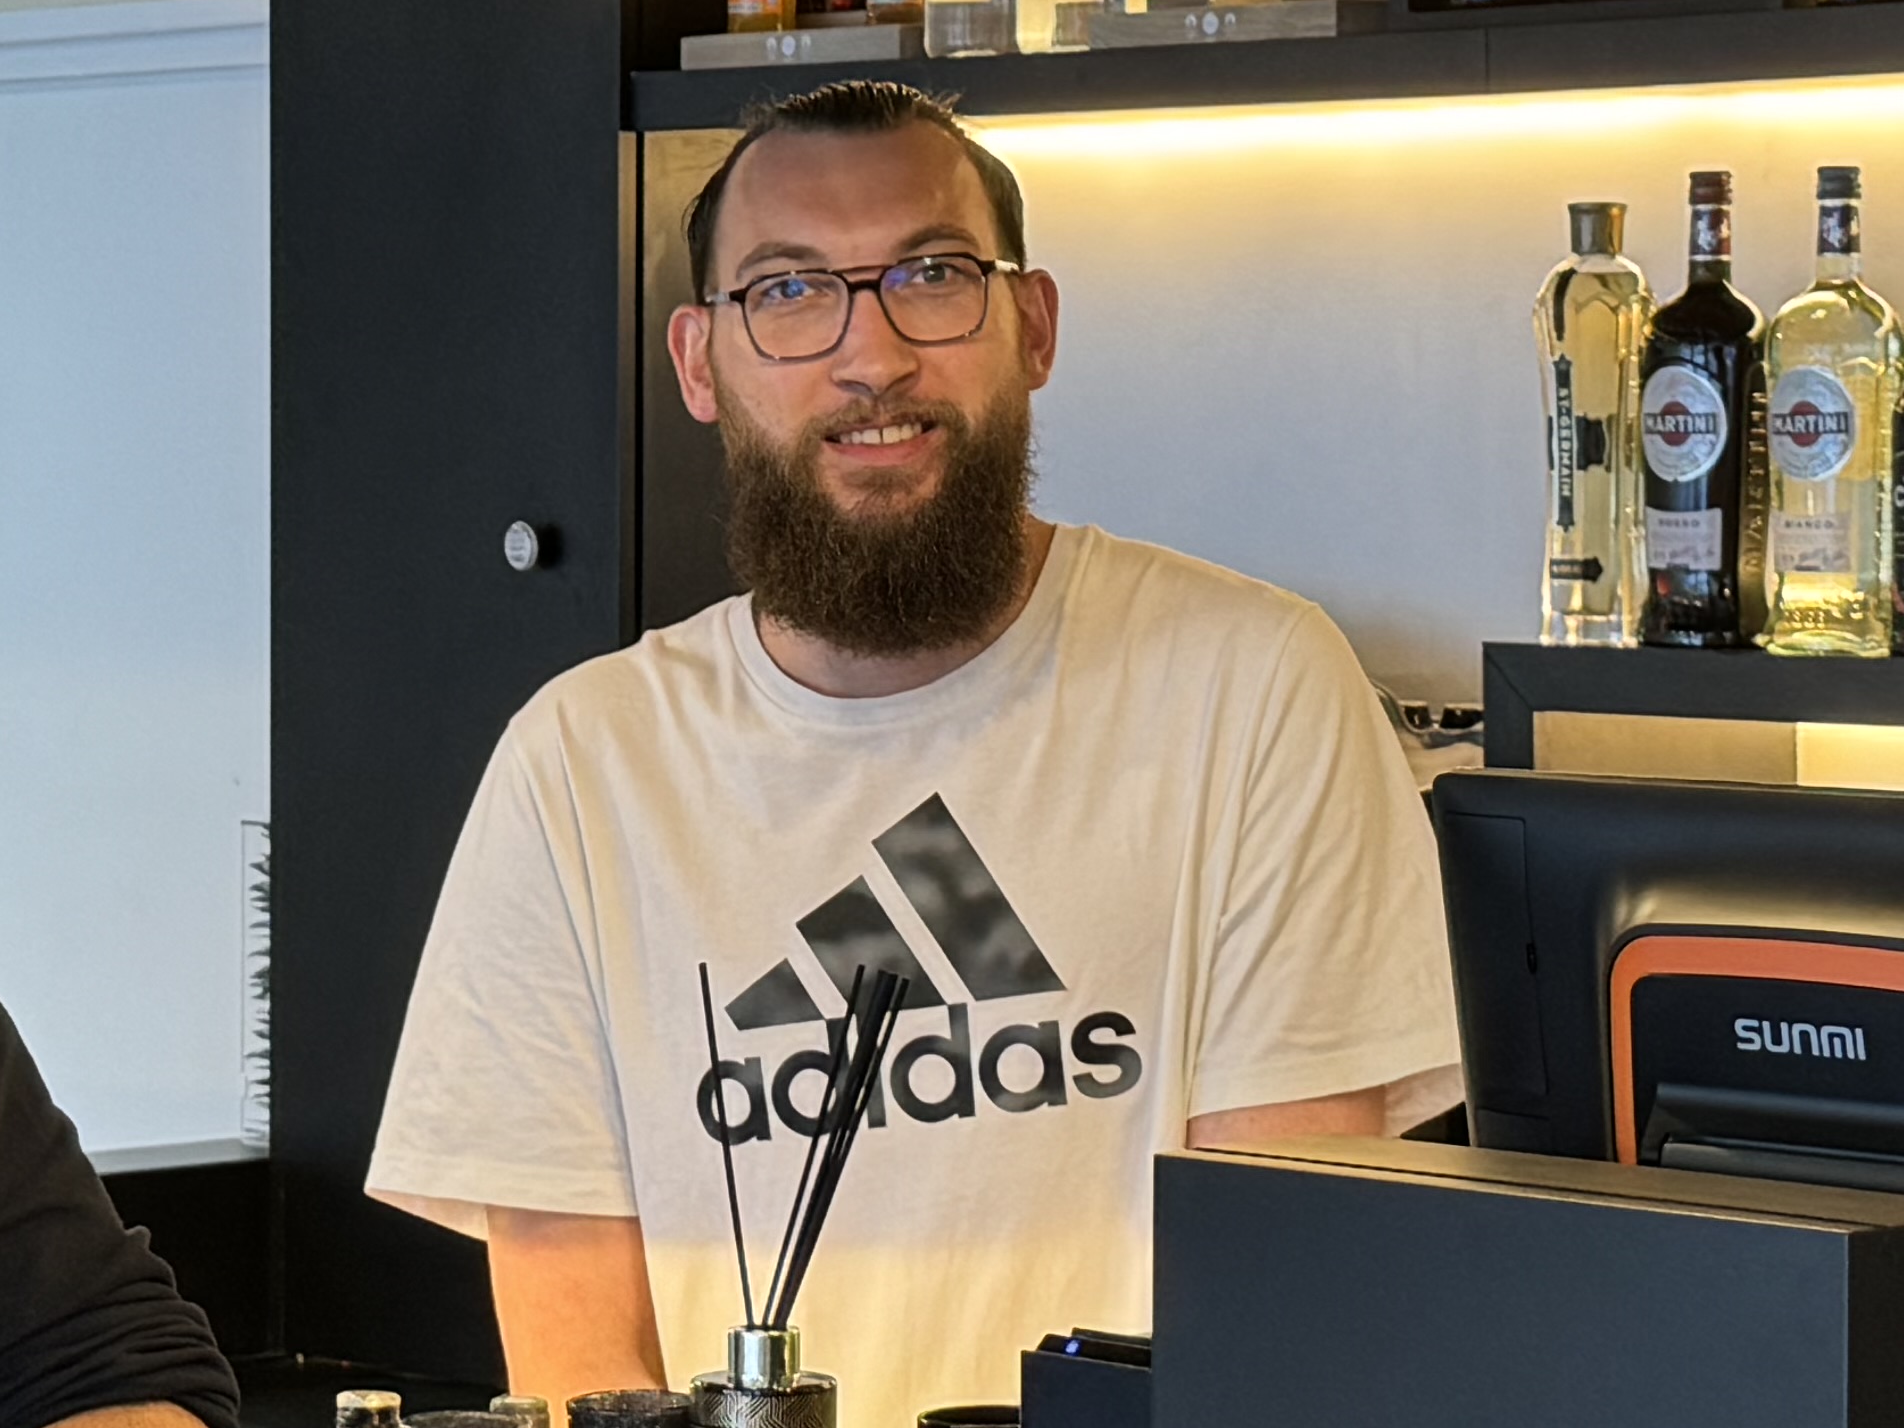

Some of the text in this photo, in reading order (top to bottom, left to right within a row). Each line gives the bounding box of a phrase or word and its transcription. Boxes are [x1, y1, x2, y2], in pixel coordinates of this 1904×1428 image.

[1647, 414, 1715, 433] MARTINI
[1773, 414, 1846, 433] MARTINI
[1734, 1018, 1867, 1062] SUNMI
[696, 1002, 1143, 1147] adidas
